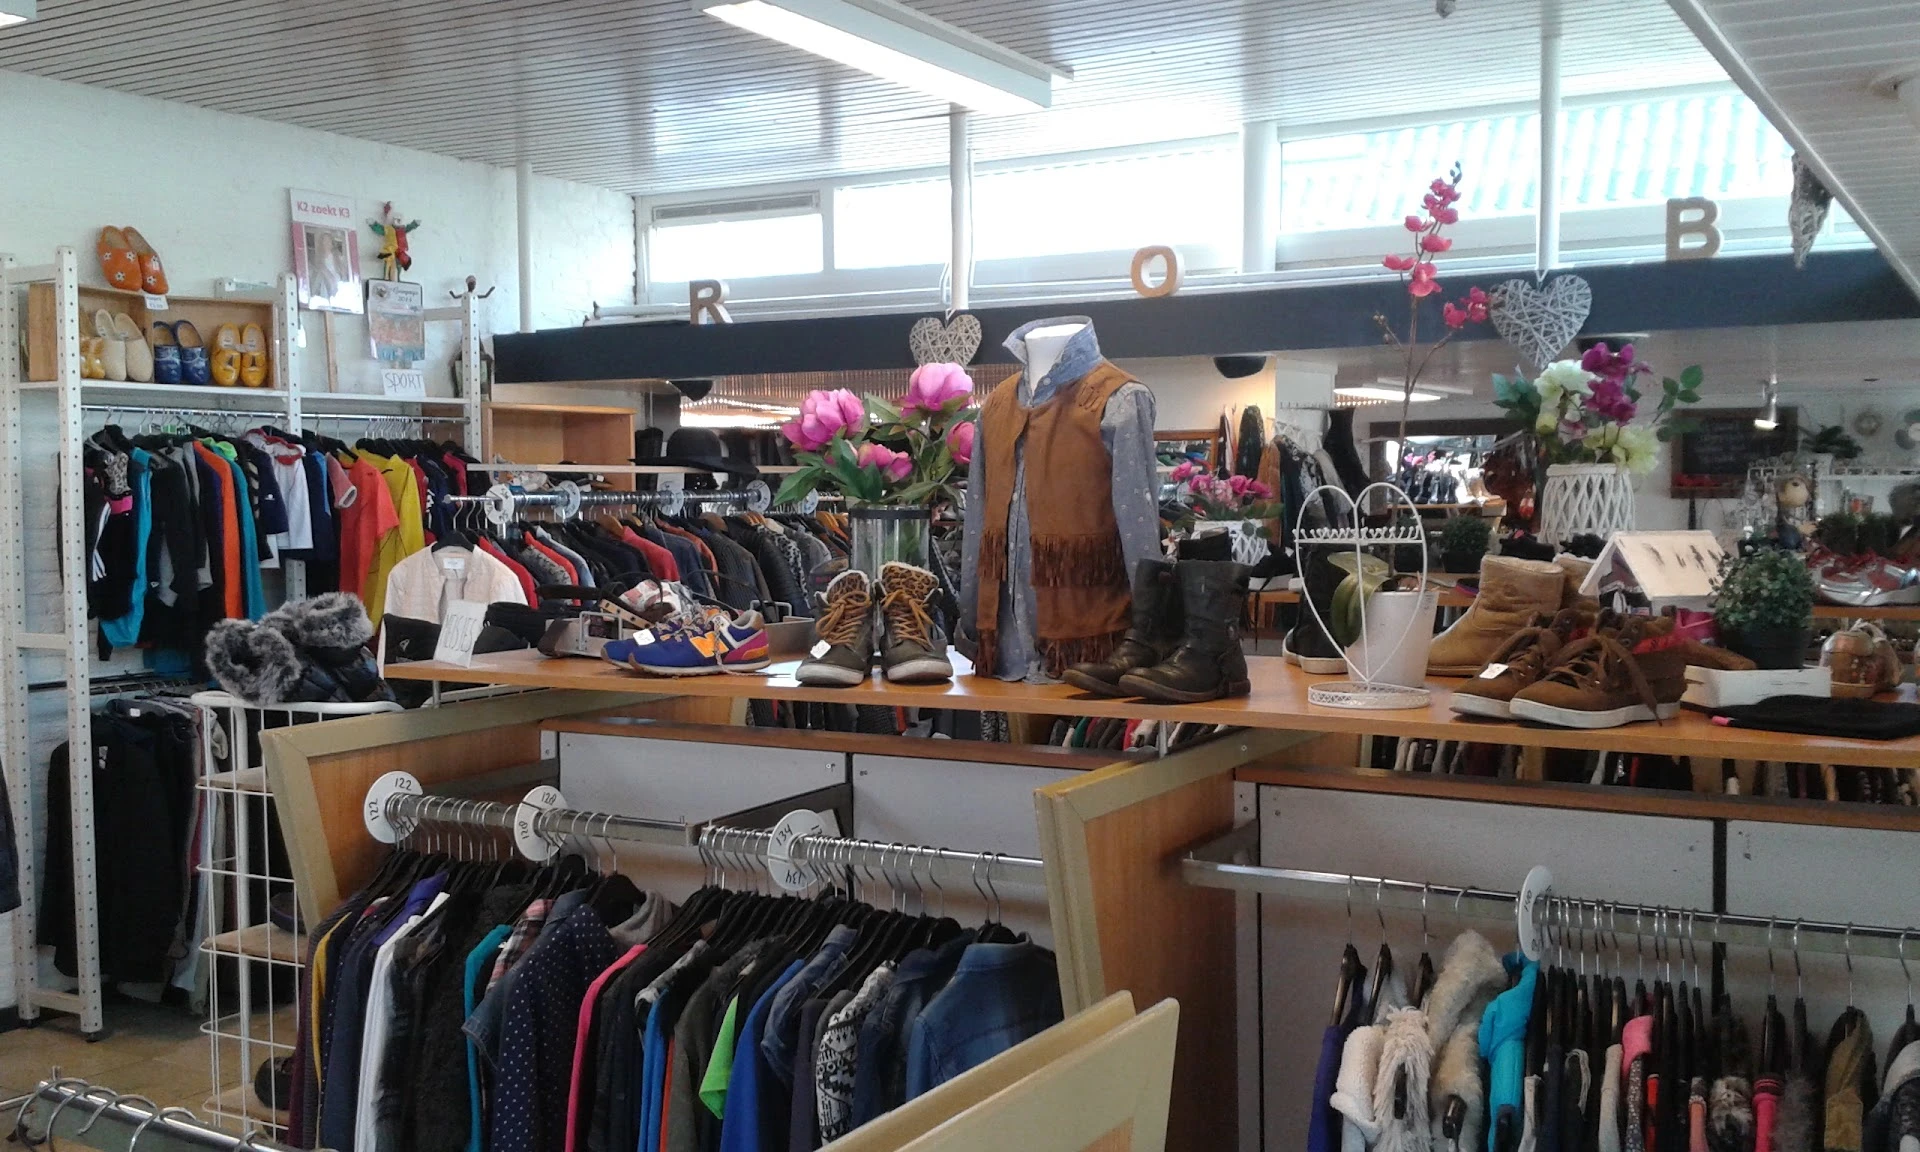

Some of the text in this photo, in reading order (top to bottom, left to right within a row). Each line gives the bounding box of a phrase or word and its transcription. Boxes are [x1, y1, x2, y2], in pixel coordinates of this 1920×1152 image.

[296, 201, 350, 218] K2 zoekt K3
[1665, 197, 1721, 260] B
[1131, 245, 1178, 298] O
[689, 279, 726, 325] R
[384, 372, 424, 393] SPORT
[394, 777, 413, 791] 122
[368, 798, 380, 821] 122
[518, 820, 530, 840] 128
[775, 823, 794, 847] 134
